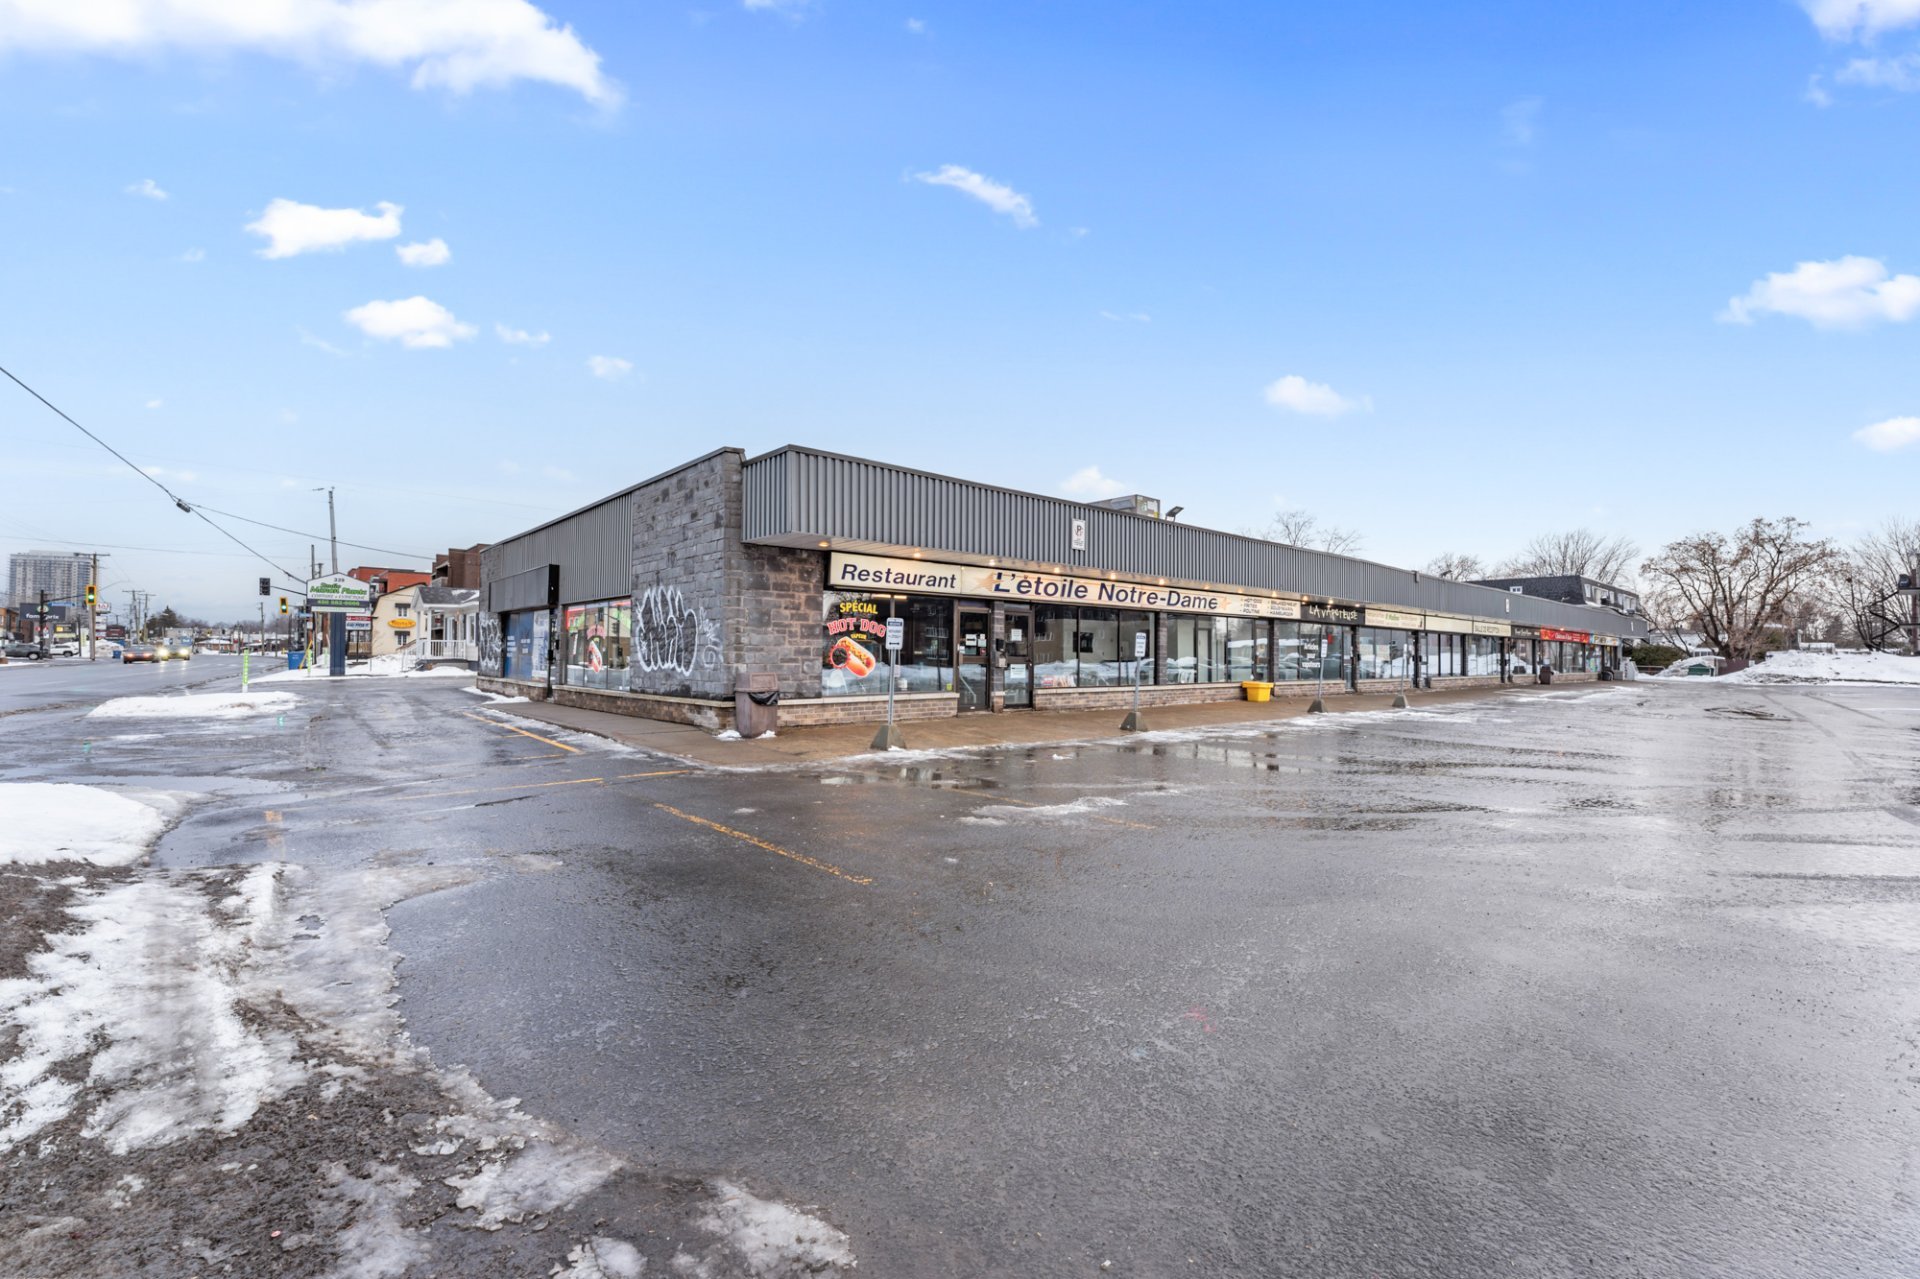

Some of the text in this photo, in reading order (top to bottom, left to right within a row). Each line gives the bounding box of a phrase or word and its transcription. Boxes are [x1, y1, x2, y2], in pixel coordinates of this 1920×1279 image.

[841, 563, 956, 589] Restaurant
[994, 572, 1219, 610] L'étoile Notre-Dame
[839, 600, 878, 614] SPÉCIAL
[1309, 604, 1321, 618] LA
[826, 617, 857, 636] HOT
[860, 618, 887, 638] DOG
